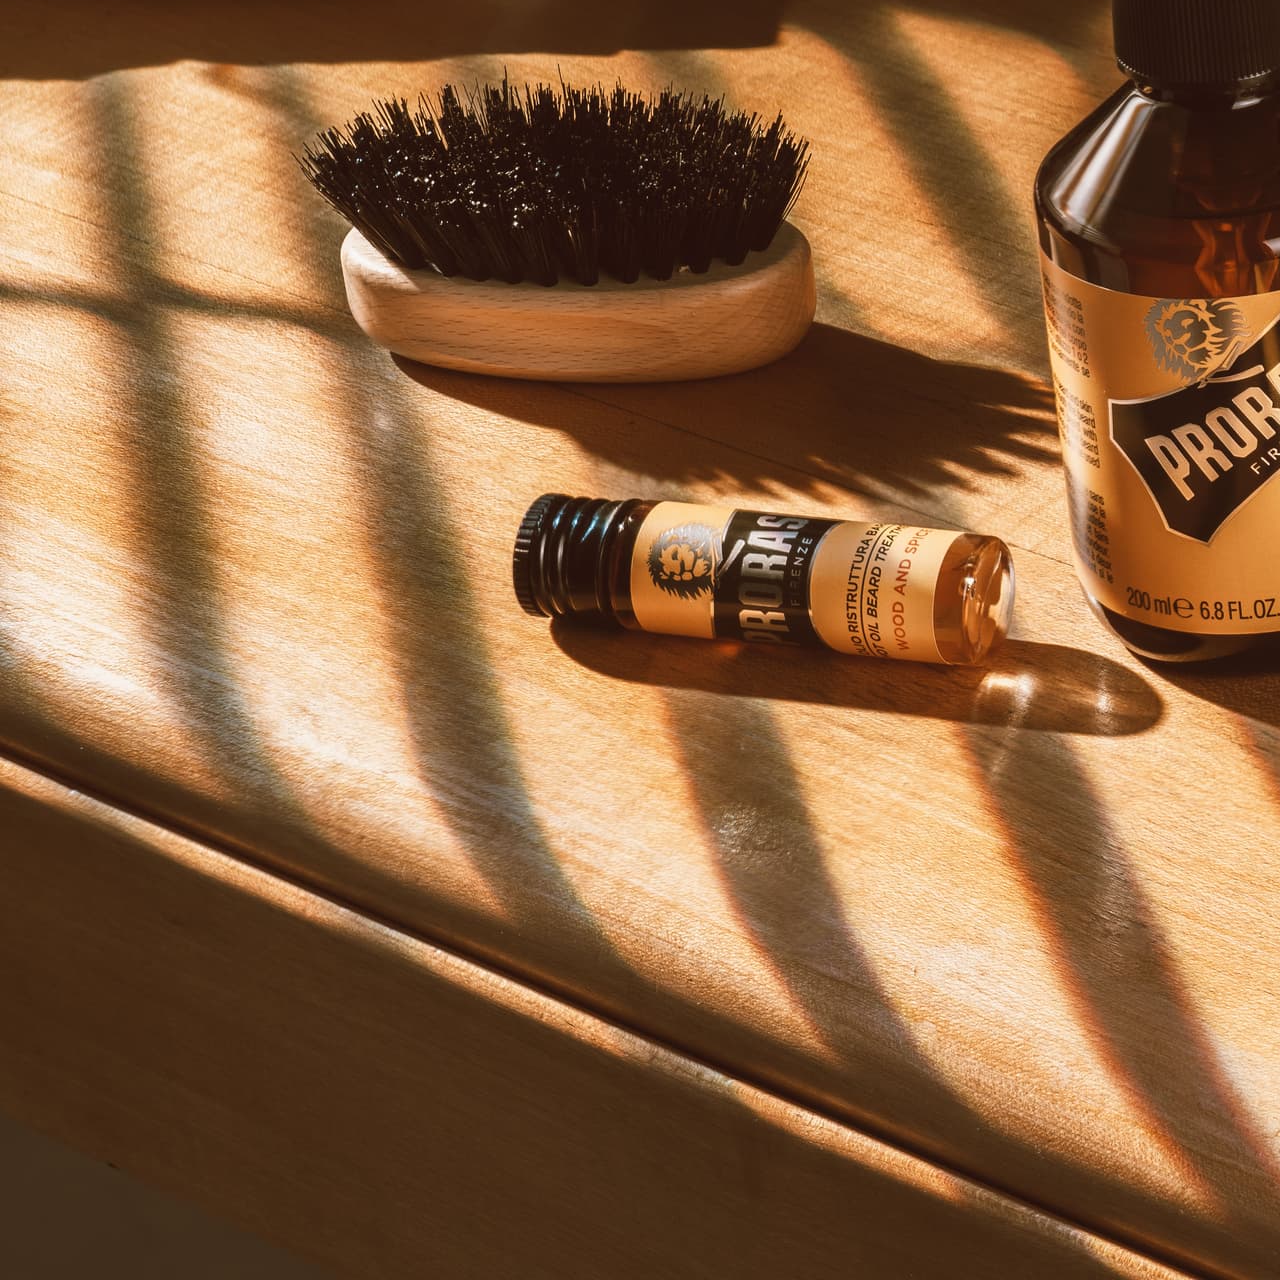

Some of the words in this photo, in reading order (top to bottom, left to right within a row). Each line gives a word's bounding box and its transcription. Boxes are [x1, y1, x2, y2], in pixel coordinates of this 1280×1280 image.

[845, 537, 873, 633] RISTRUTTURA
[866, 565, 882, 619] BEARD
[893, 558, 912, 596] AND
[1126, 586, 1151, 611] 200
[1153, 596, 1172, 616] ml
[1199, 600, 1225, 621] 6.8
[867, 622, 882, 642] OIL
[891, 601, 911, 651] WOOD
